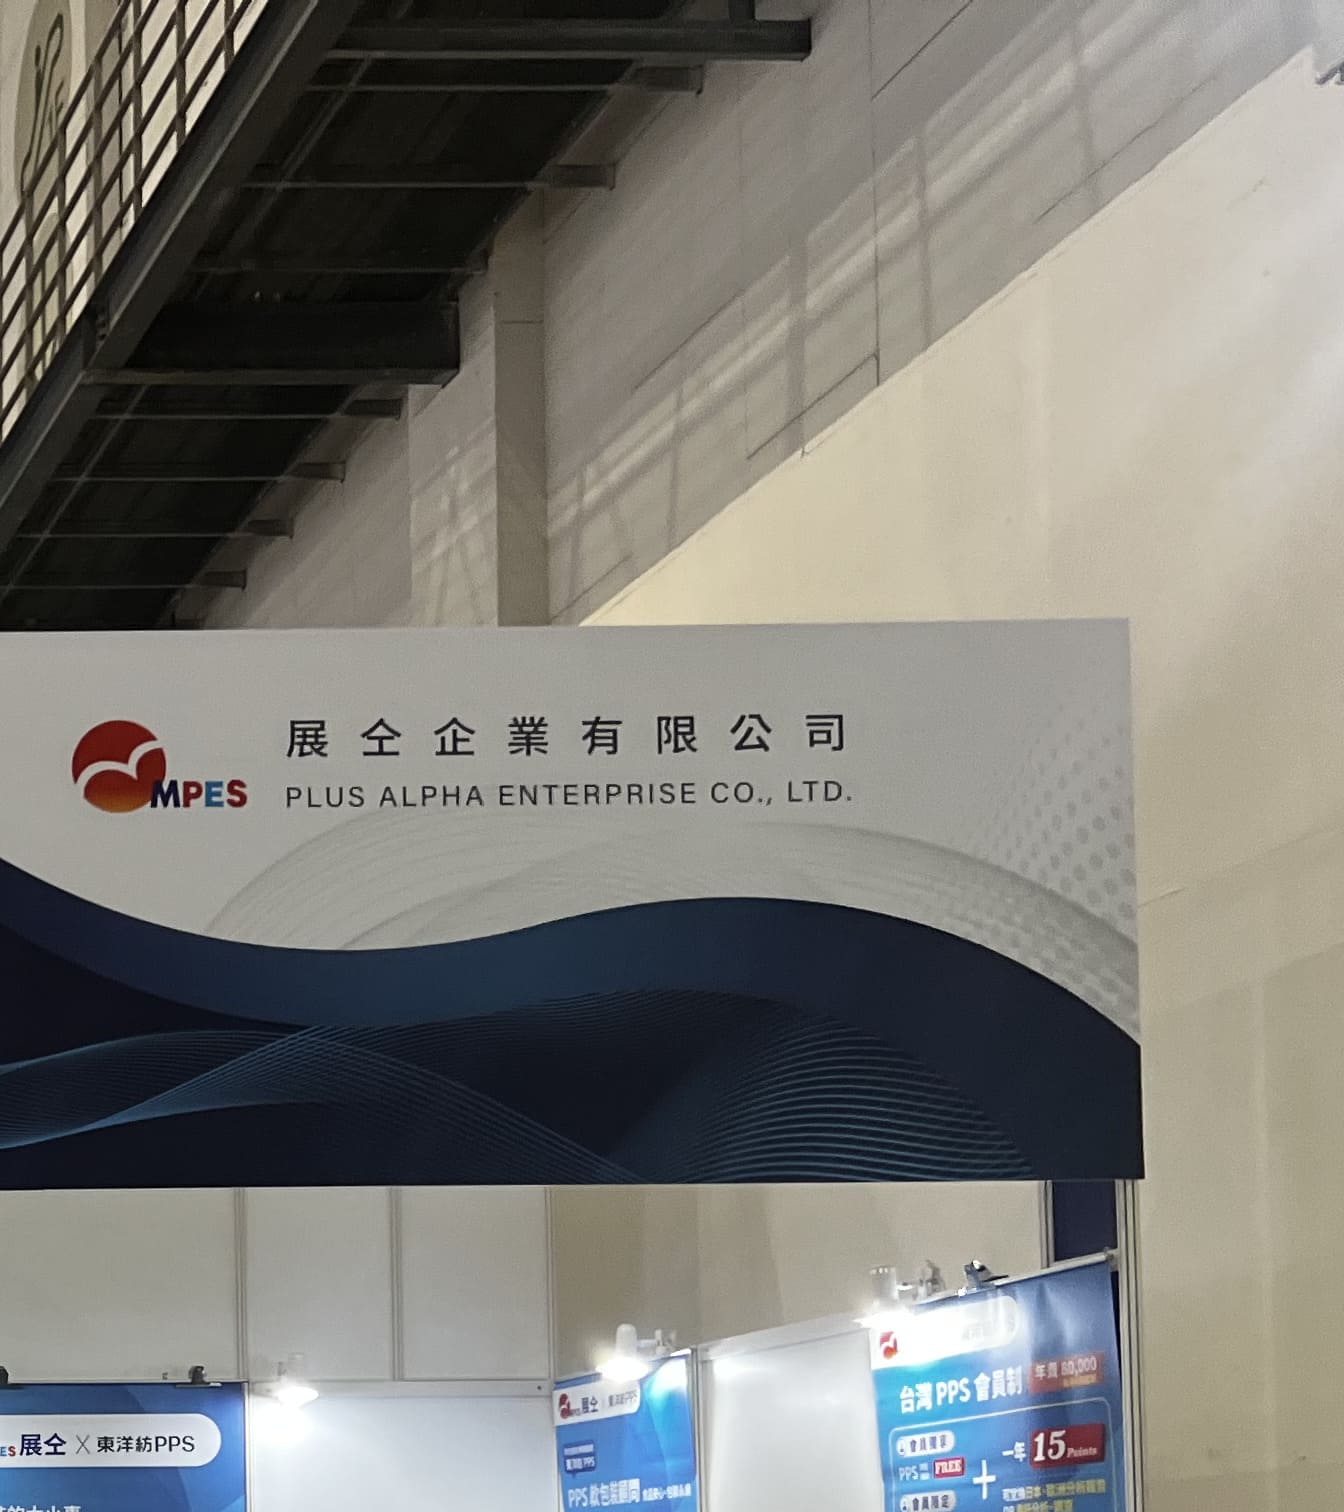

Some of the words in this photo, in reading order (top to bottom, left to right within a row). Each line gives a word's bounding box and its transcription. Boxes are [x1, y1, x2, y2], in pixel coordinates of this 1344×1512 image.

[150, 780, 248, 809] MPES
[286, 786, 365, 808] PLUS
[379, 785, 485, 807] ALPHA
[498, 782, 697, 806] ENTERPRISE
[711, 782, 772, 806] CO.,
[787, 781, 852, 803] LTD.
[936, 1377, 971, 1406] PPS
[1033, 1430, 1067, 1461] 15
